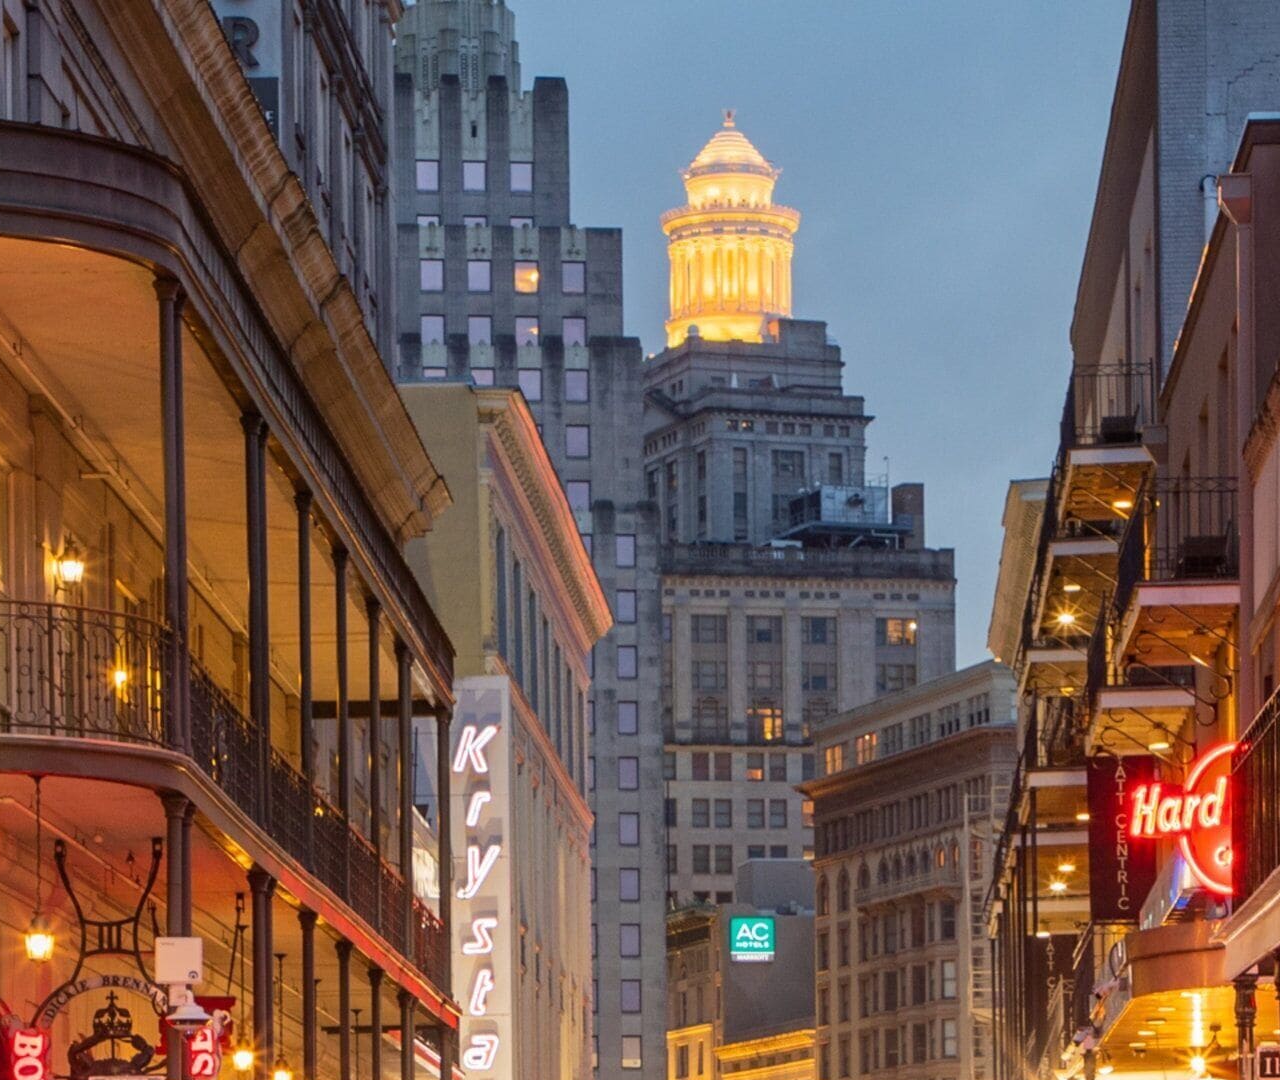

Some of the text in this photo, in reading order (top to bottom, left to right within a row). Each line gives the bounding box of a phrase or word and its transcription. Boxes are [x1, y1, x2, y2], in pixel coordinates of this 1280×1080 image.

[1131, 776, 1228, 837] Hard
[1115, 813, 1129, 910] CENTRIC
[736, 922, 768, 940] AC
